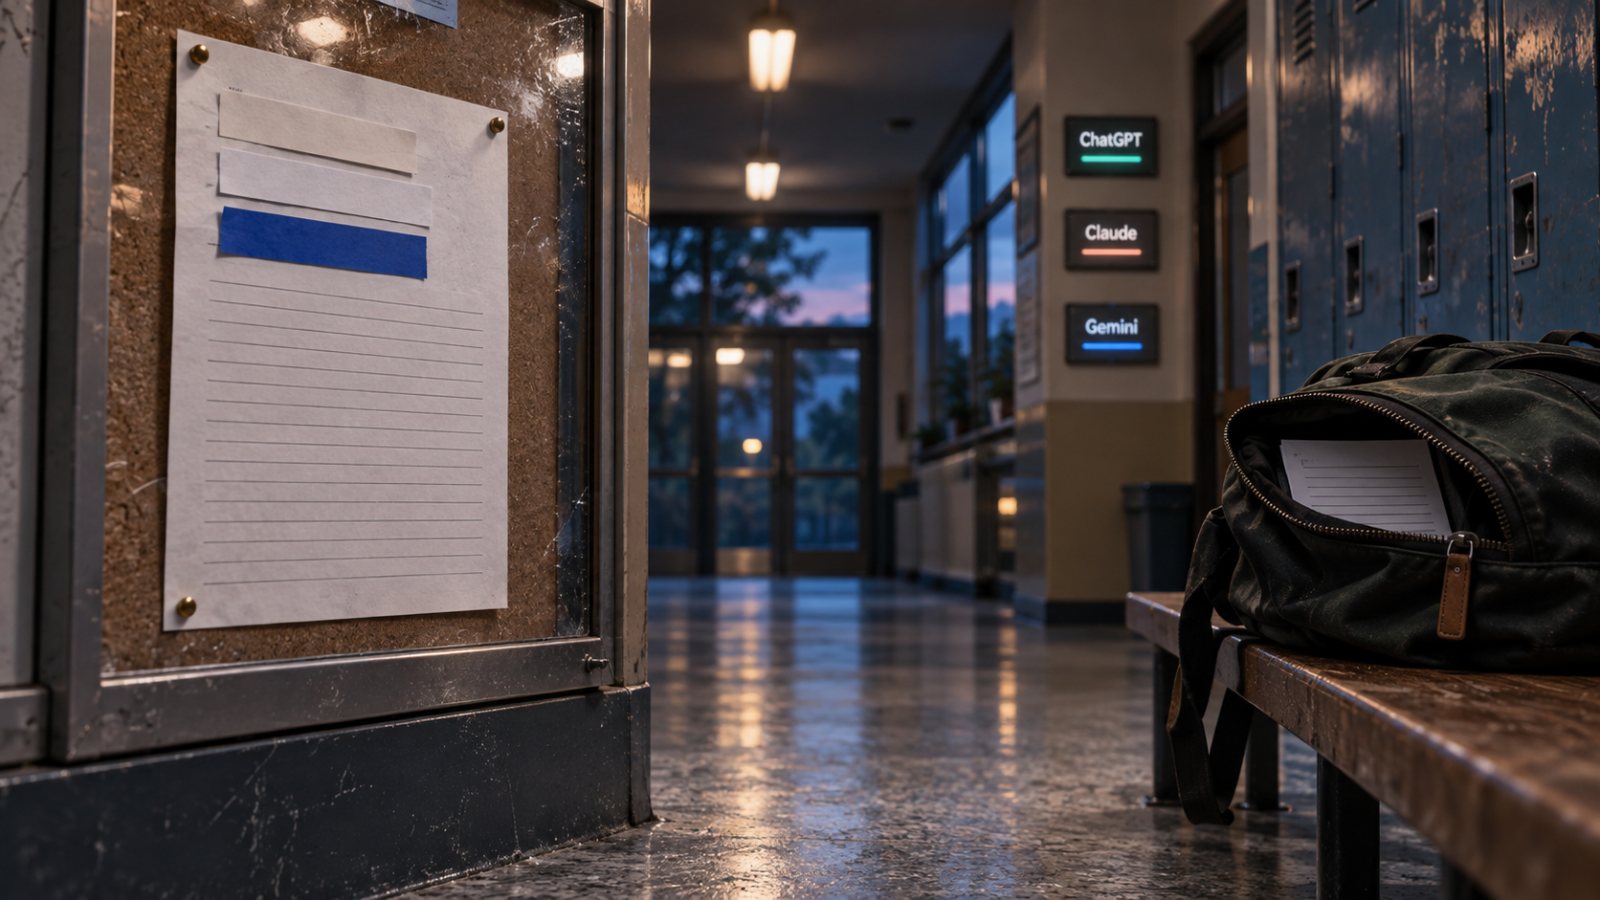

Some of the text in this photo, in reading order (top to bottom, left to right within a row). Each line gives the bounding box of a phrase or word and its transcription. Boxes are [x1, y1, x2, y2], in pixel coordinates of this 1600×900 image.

[1079, 131, 1143, 148] ChatGPT
[1085, 224, 1138, 241] Claude
[1085, 317, 1138, 335] Gemini
